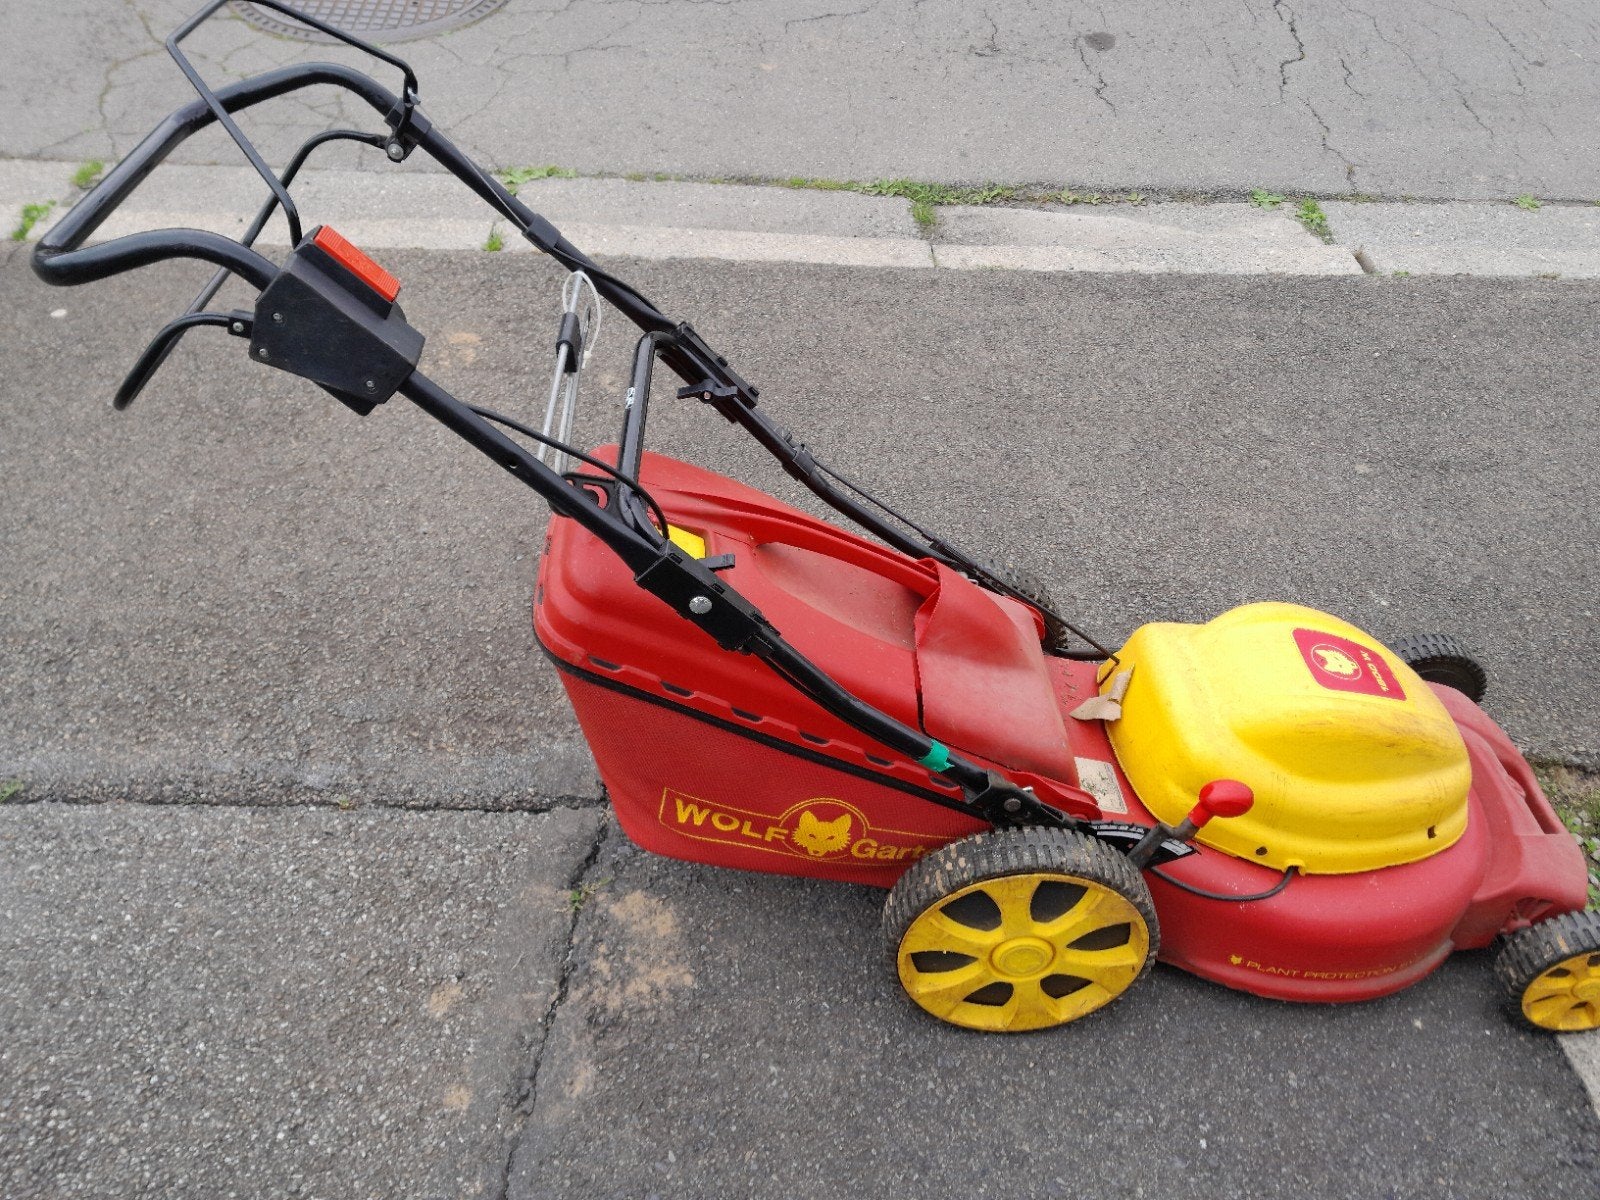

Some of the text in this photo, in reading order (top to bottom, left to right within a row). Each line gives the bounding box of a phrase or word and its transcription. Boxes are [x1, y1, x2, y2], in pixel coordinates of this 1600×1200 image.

[675, 799, 927, 860] WOLF Gart
[1247, 960, 1300, 977] PLANT
